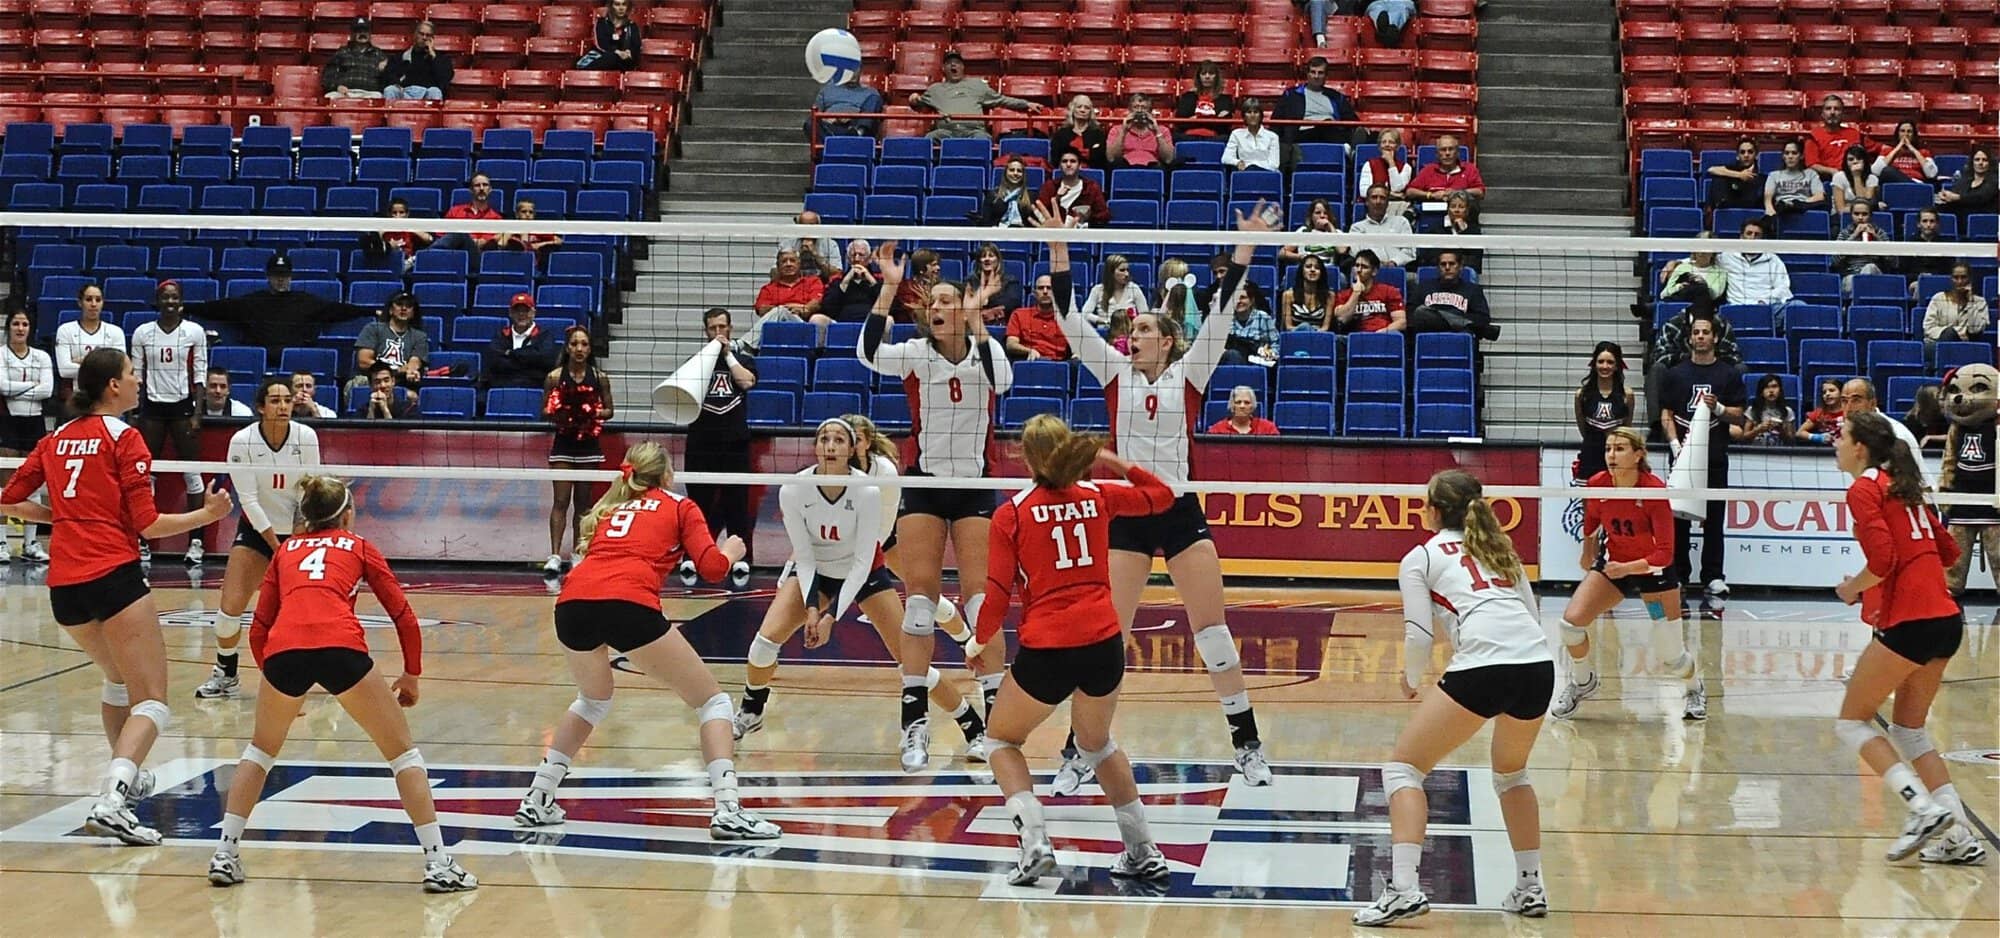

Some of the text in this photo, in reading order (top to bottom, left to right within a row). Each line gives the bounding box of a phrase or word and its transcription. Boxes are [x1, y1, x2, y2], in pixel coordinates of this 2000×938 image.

[160, 347, 173, 363] 13
[377, 338, 407, 370] A
[707, 371, 734, 397] A
[949, 377, 963, 403] 8
[1145, 394, 1158, 421] 9
[1594, 401, 1615, 420] A
[56, 438, 102, 455] UTAH
[1961, 433, 1986, 462] A
[64, 458, 84, 498] 7
[272, 473, 286, 489] 11
[1031, 499, 1098, 523] UTAH
[1197, 491, 1523, 533] LLS FARO
[1727, 500, 1850, 532] DCAT
[1905, 505, 1935, 540] 14
[606, 511, 635, 538] 9
[820, 524, 841, 541] 14
[1611, 517, 1635, 537] 33
[286, 536, 355, 551] UTAH
[1051, 522, 1093, 569] 11
[1739, 543, 1851, 555] MEMBER
[298, 547, 327, 580] 4
